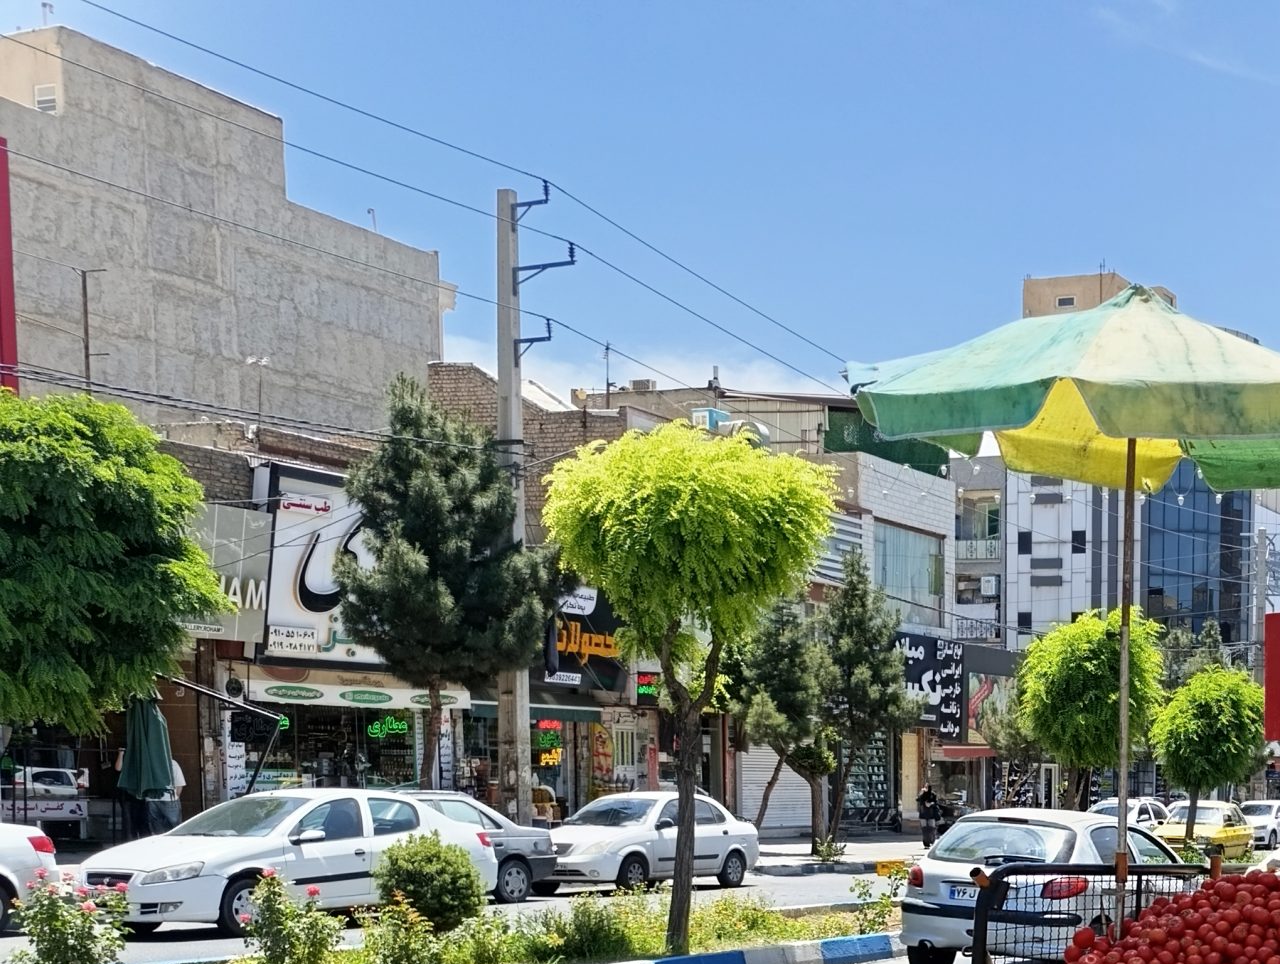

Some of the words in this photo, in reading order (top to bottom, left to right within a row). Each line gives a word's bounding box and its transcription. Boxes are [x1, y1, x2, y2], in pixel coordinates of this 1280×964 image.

[941, 662, 962, 679] ایرانی
[940, 681, 962, 699] خارجی
[940, 701, 961, 718] زنانه
[367, 715, 408, 738] عطاری
[939, 720, 960, 738] مردانه
